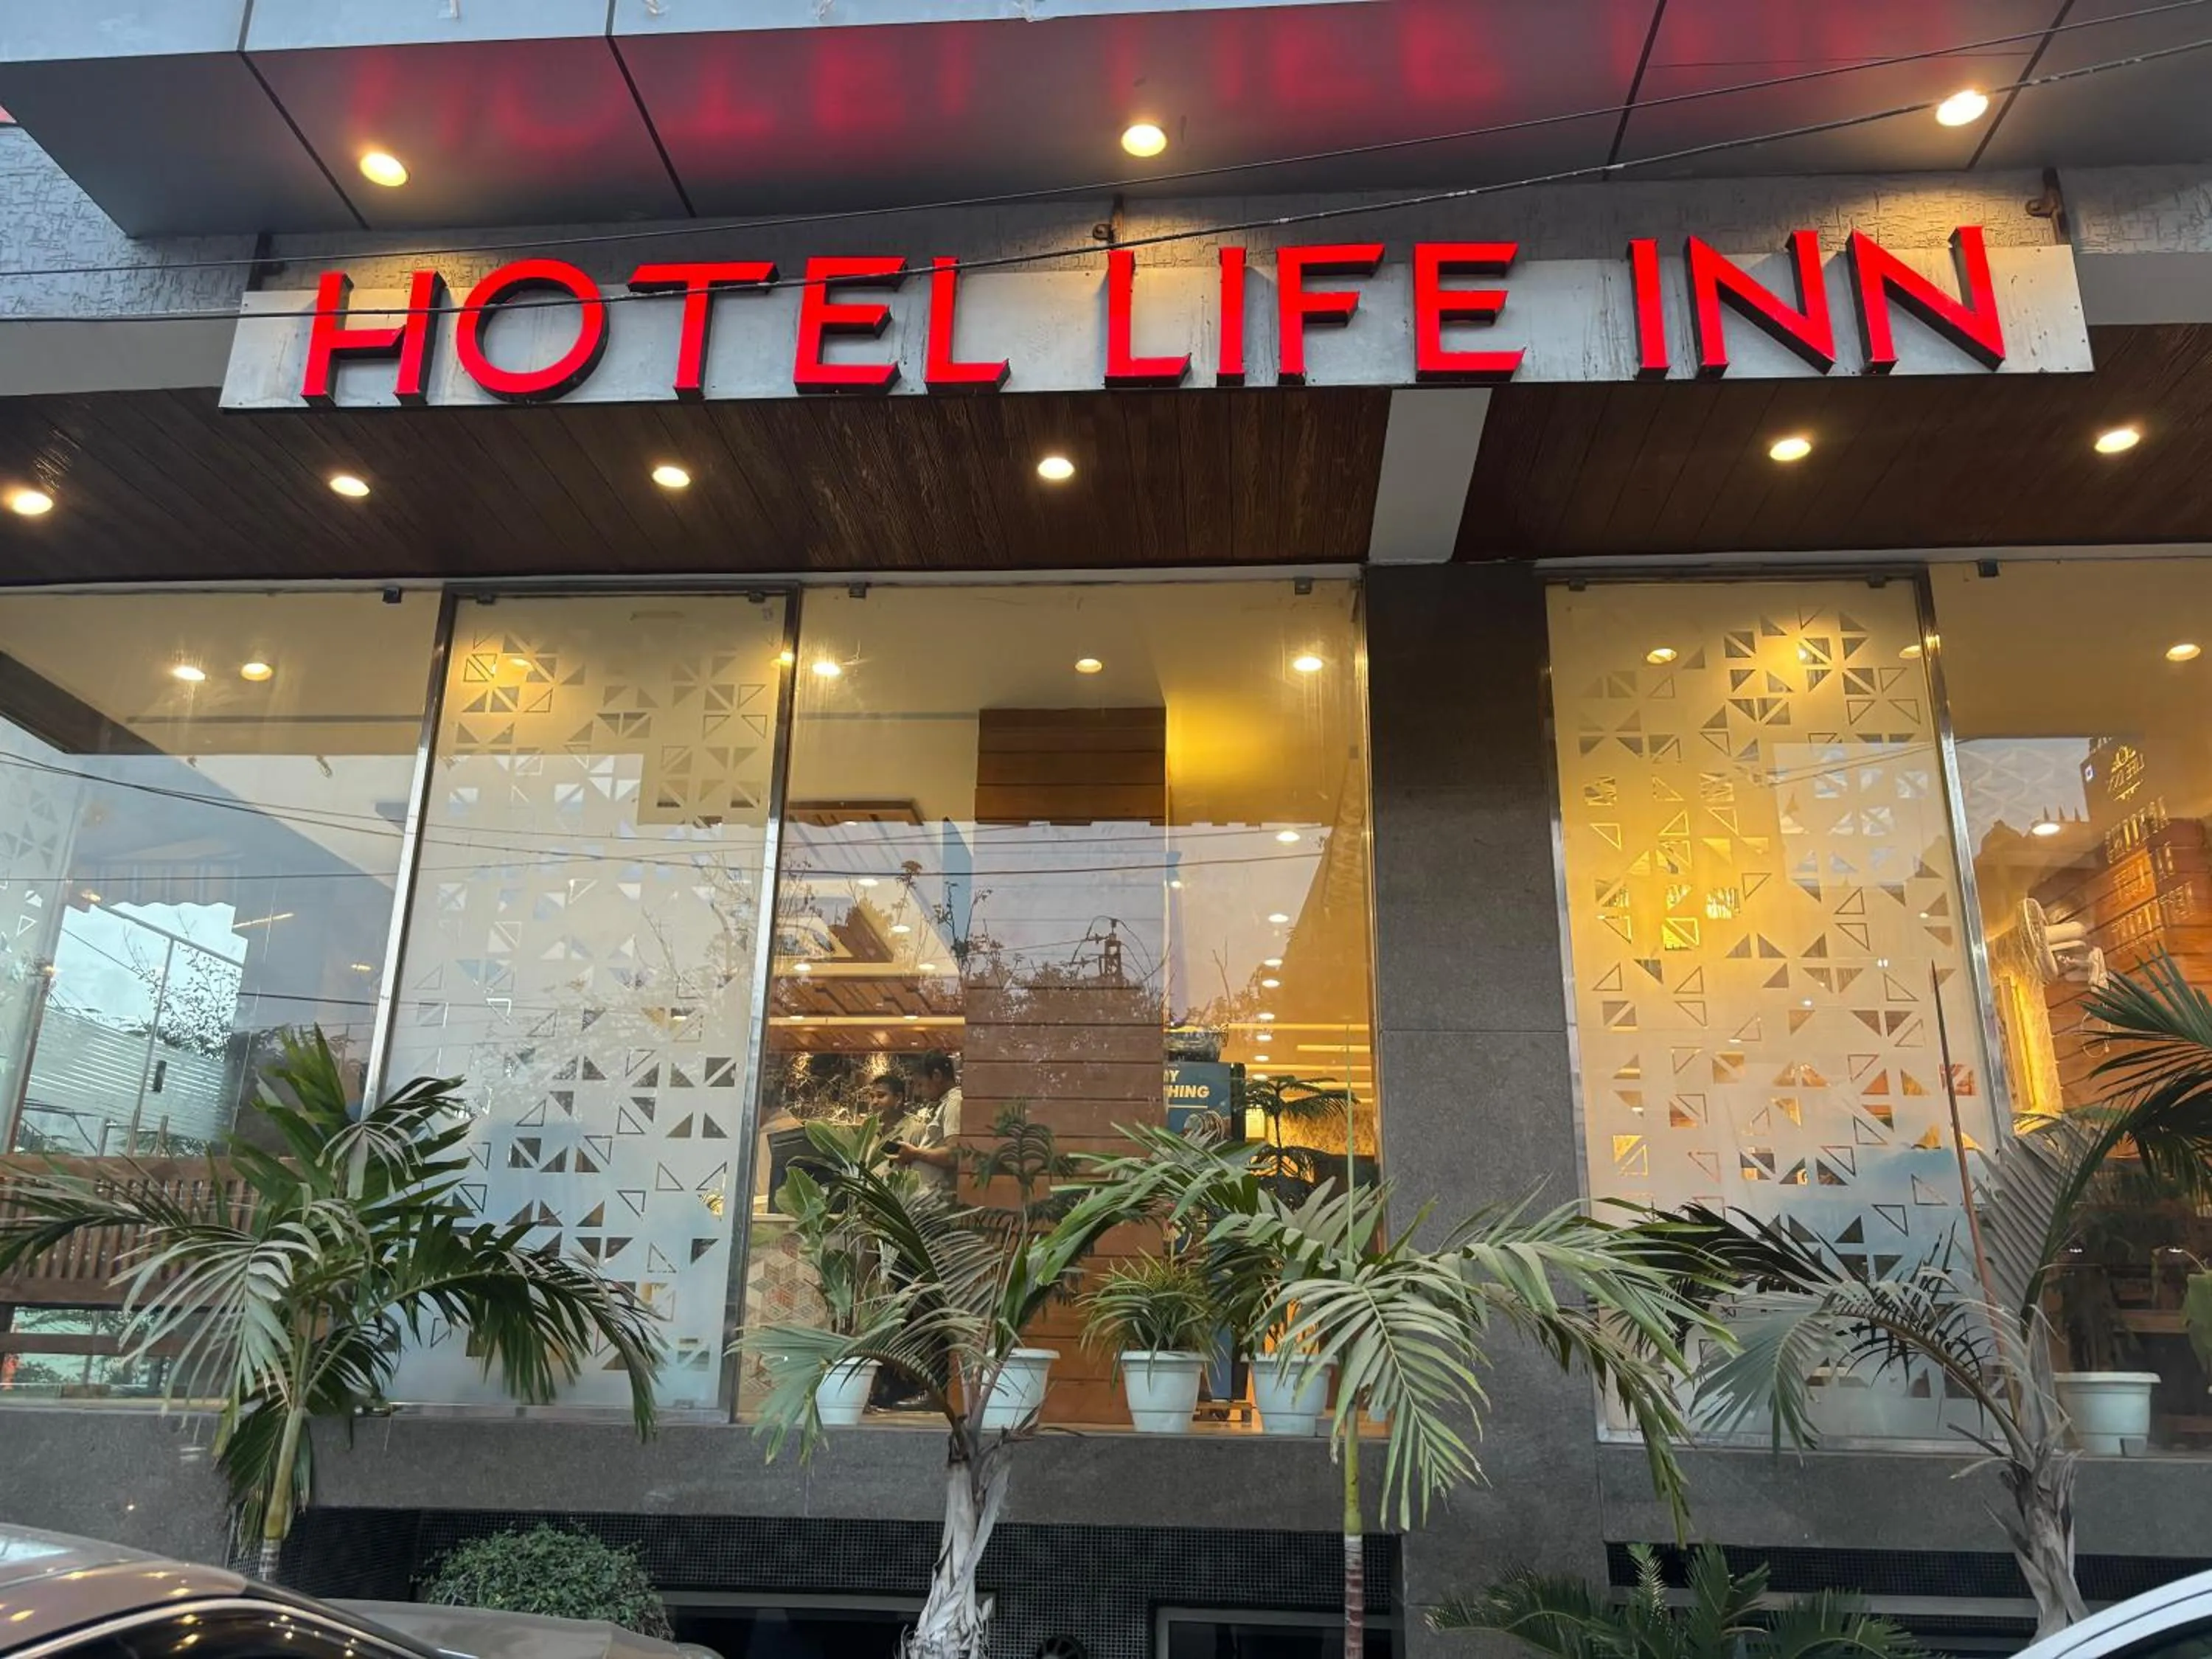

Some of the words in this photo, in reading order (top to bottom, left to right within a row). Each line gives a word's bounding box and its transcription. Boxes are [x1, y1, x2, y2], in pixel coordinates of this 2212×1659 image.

[302, 257, 1008, 398] HOTEL
[1105, 243, 1525, 381] LIFE
[1629, 226, 2004, 375] INN
